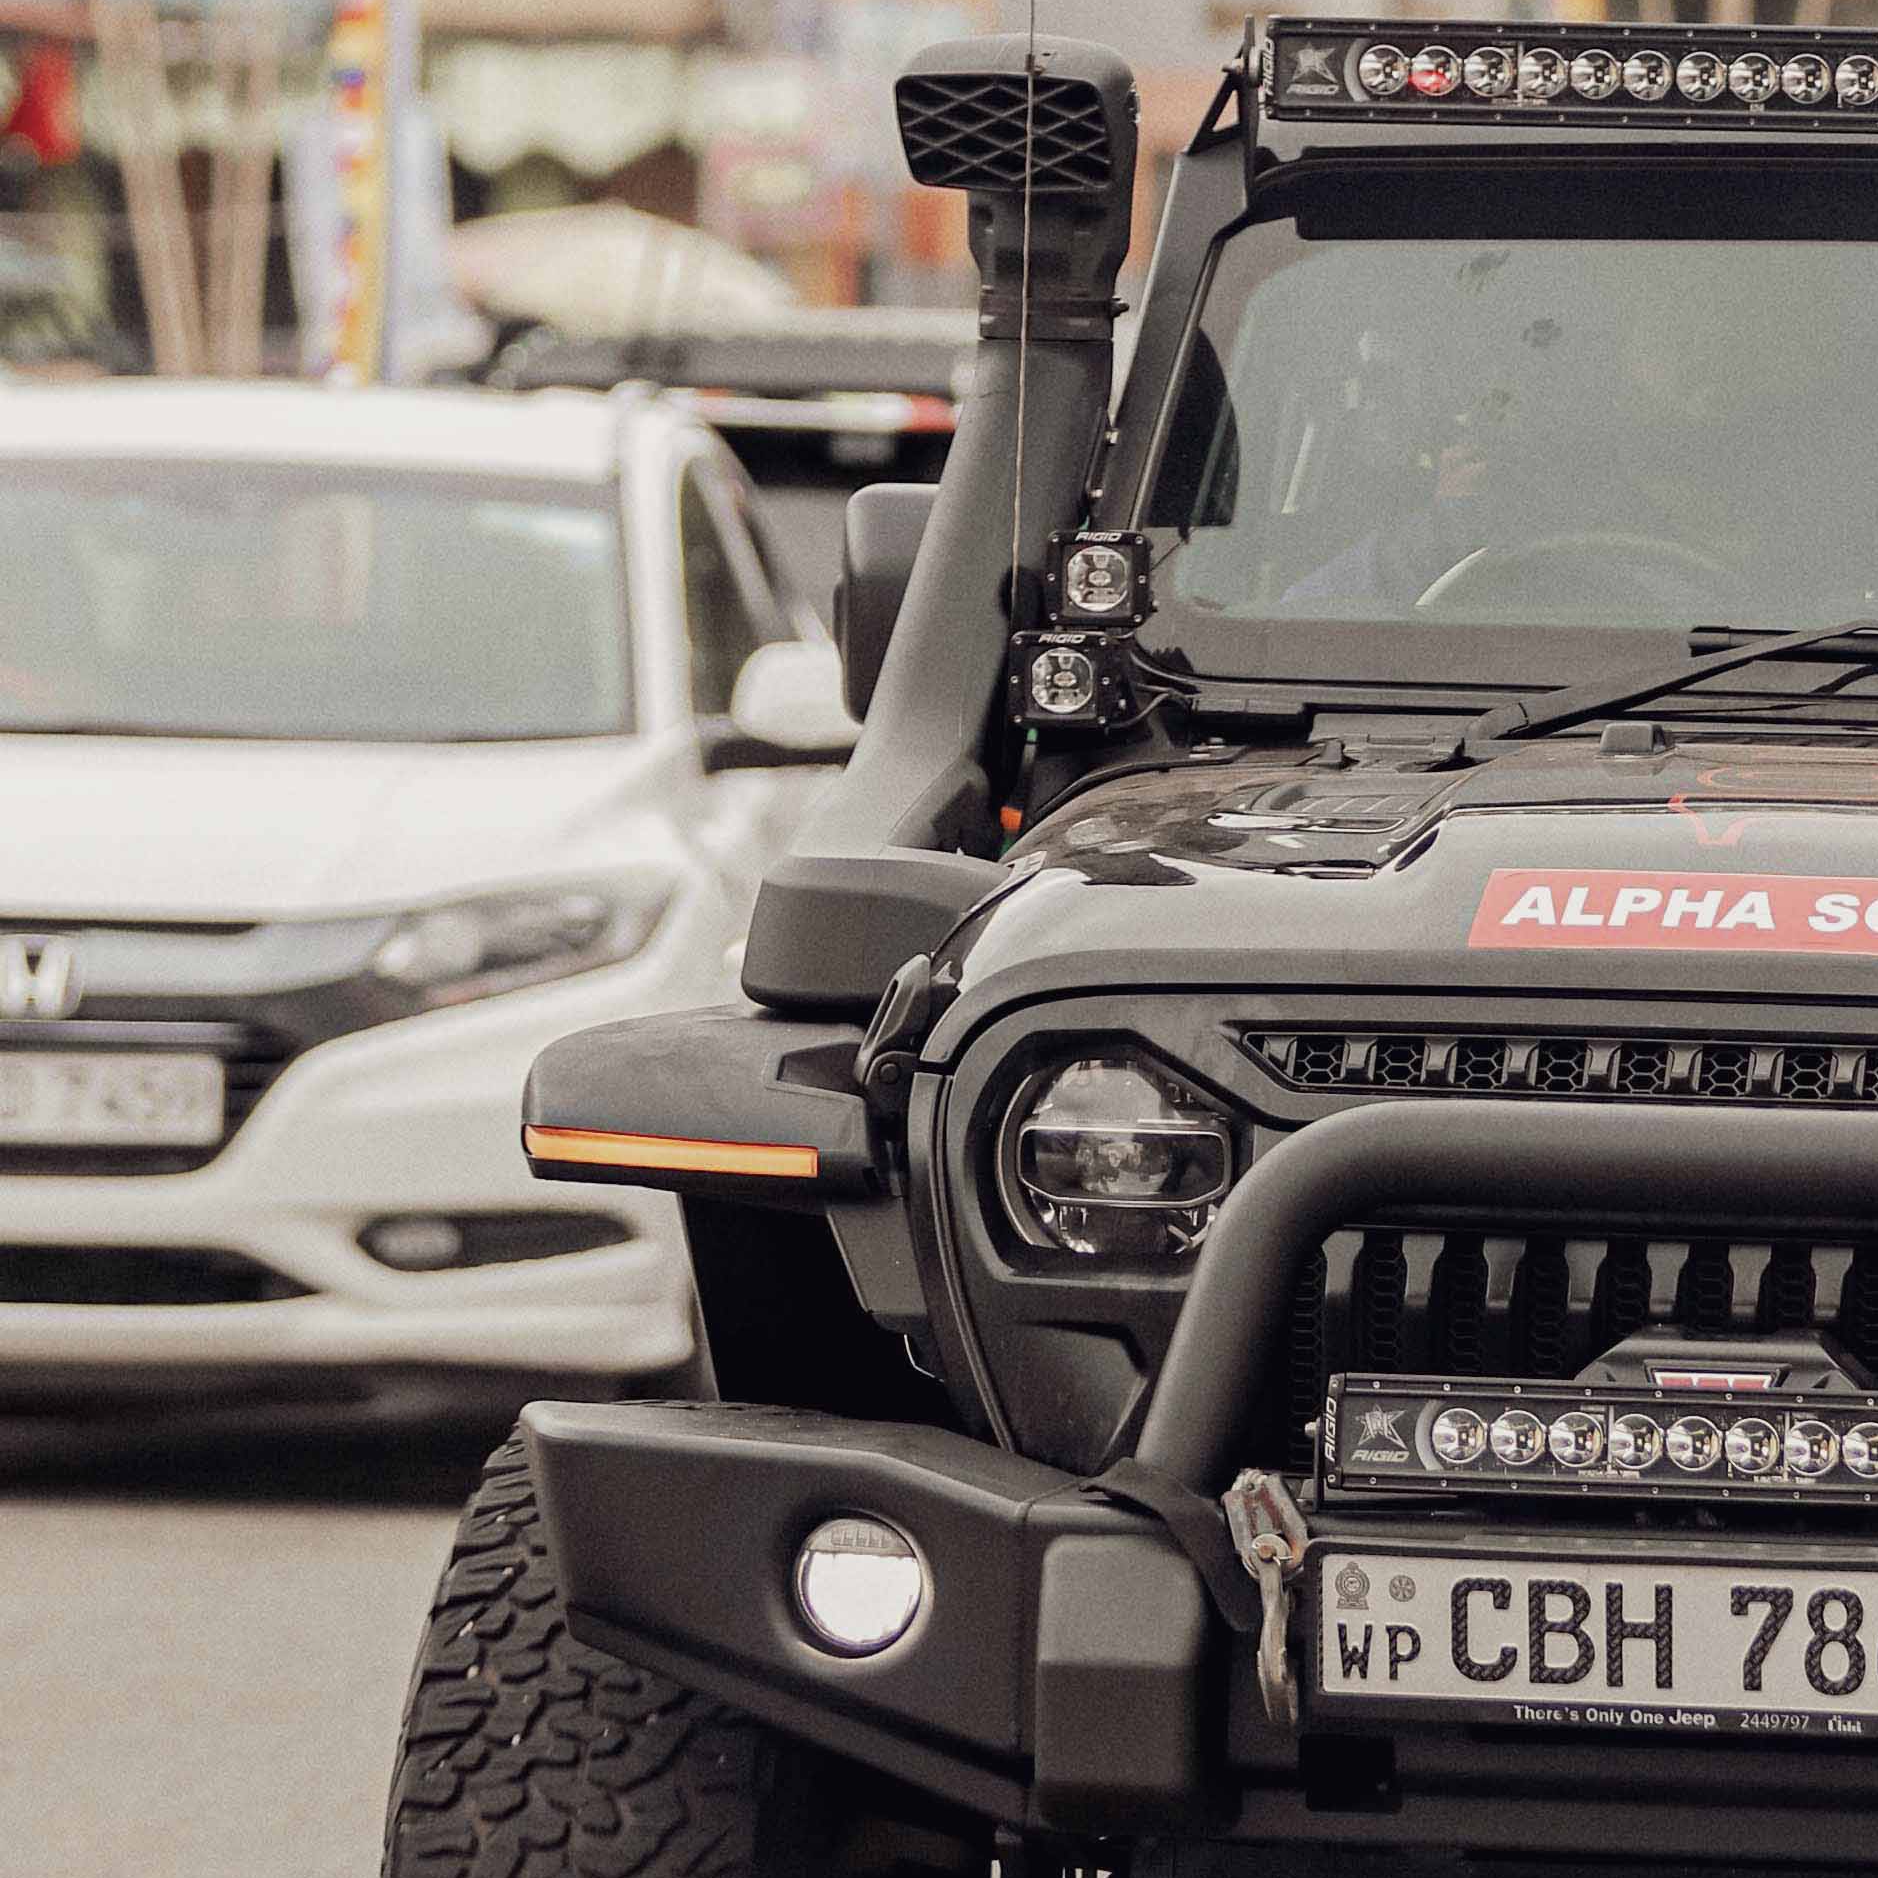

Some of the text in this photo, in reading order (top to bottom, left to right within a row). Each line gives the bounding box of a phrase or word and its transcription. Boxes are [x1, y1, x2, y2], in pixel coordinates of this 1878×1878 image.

[1263, 38, 1275, 96] RIGID
[1074, 532, 1122, 542] RIGID
[1038, 634, 1086, 644] RIGID
[1501, 886, 1775, 930] ALPHA
[1324, 1396, 1337, 1462] RIGID
[1351, 1449, 1410, 1462] RIGID
[1450, 1577, 1674, 1690] CBH
[1514, 1704, 1579, 1722] There's
[1586, 1708, 1625, 1725] Only
[1630, 1710, 1664, 1724] One
[1669, 1709, 1716, 1728] Jeep
[1740, 1713, 1810, 1729] 2449797
